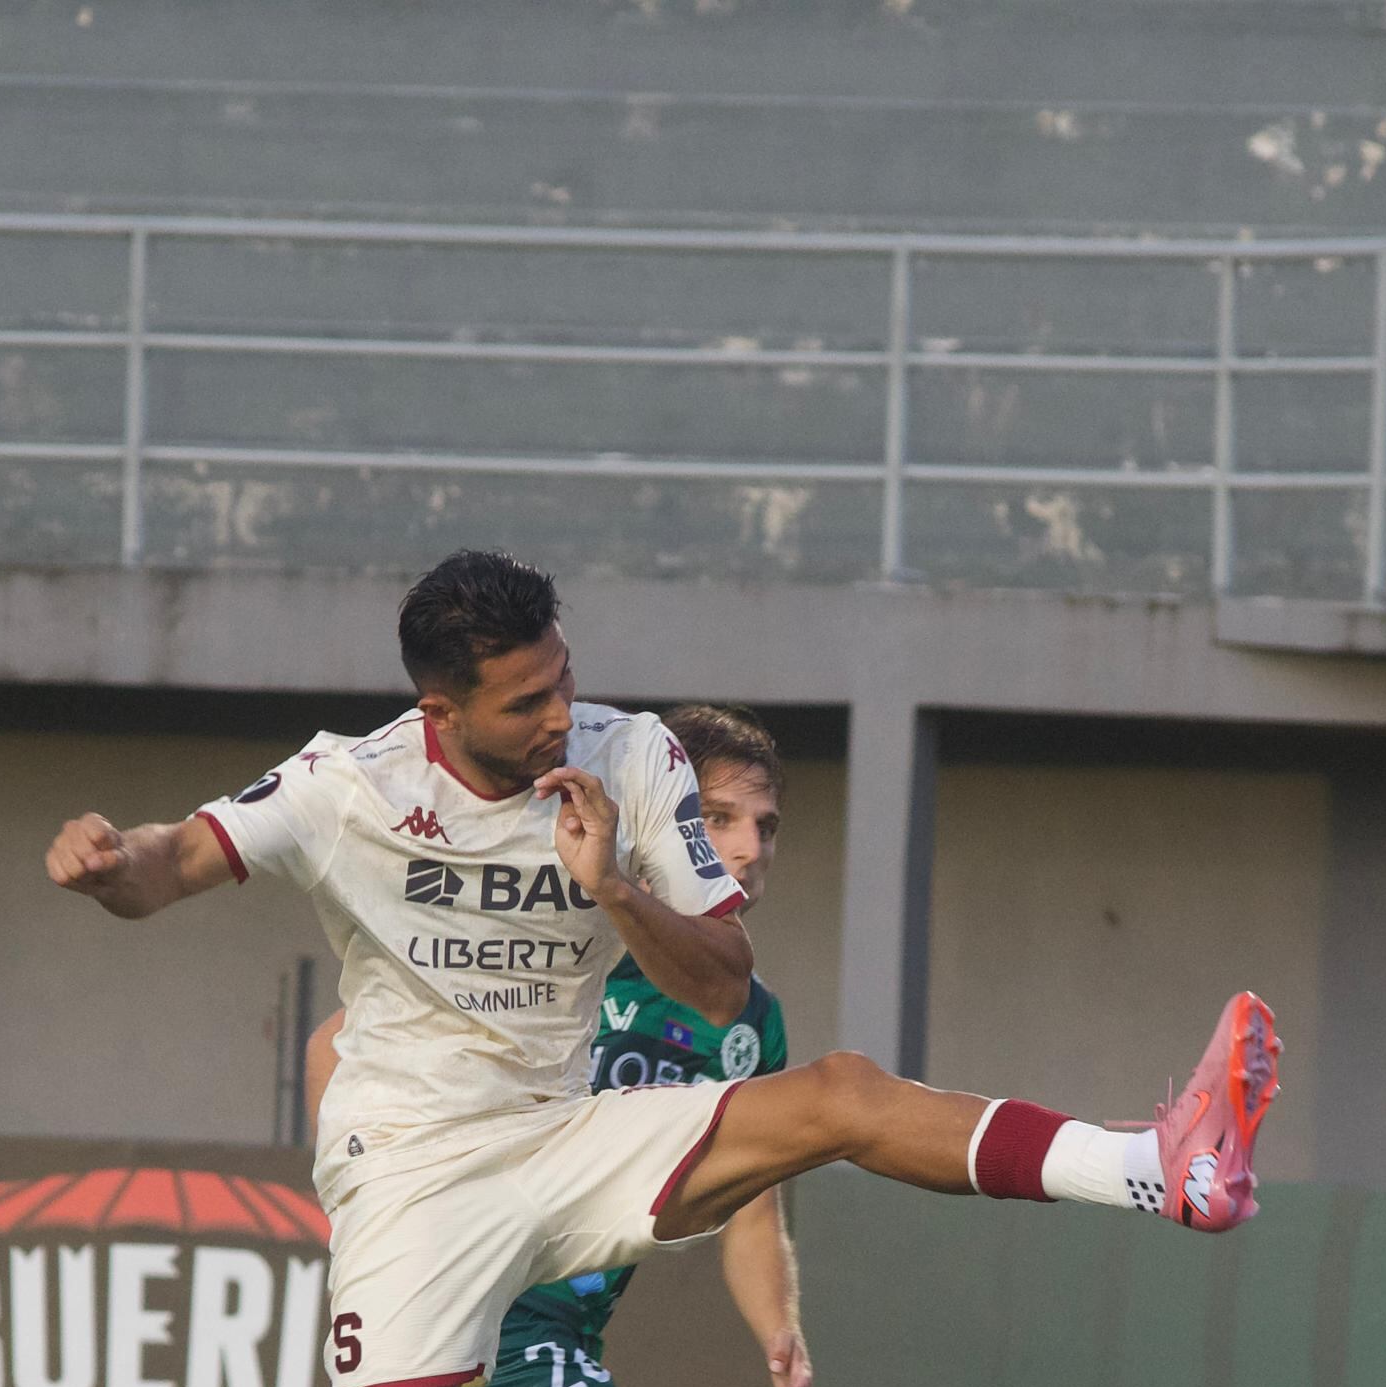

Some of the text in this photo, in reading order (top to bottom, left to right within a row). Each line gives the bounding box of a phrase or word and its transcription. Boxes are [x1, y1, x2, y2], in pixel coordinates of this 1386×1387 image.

[408, 936, 596, 970] LIBERTY
[454, 983, 561, 1013] OMNILIFE
[333, 1312, 363, 1374] S
